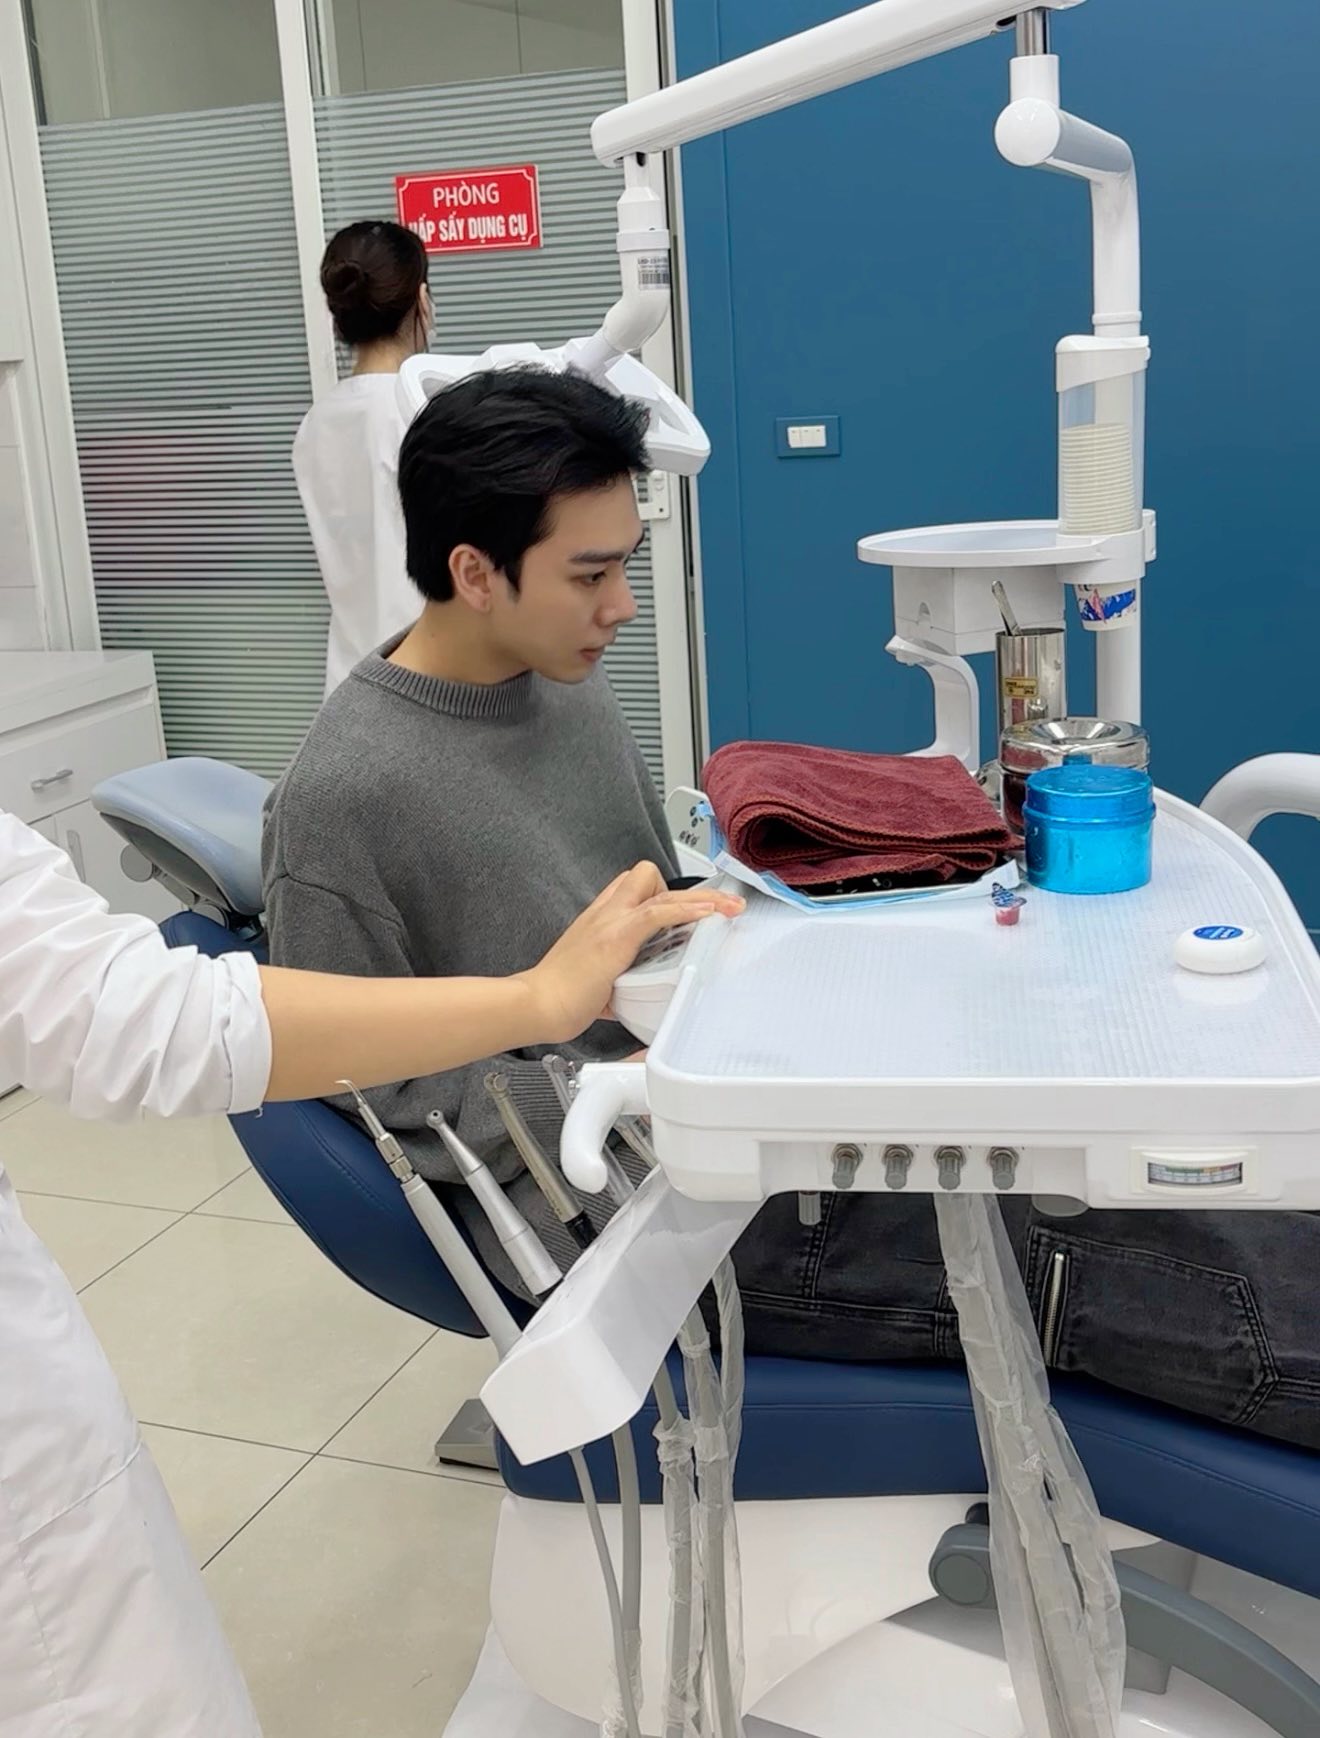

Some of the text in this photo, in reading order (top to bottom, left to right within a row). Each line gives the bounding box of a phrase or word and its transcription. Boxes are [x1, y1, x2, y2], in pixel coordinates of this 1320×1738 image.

[433, 180, 500, 208] PHÒNG
[439, 211, 465, 242] SẤY
[468, 215, 506, 243] DỤNG
[509, 213, 528, 240] CỤ
